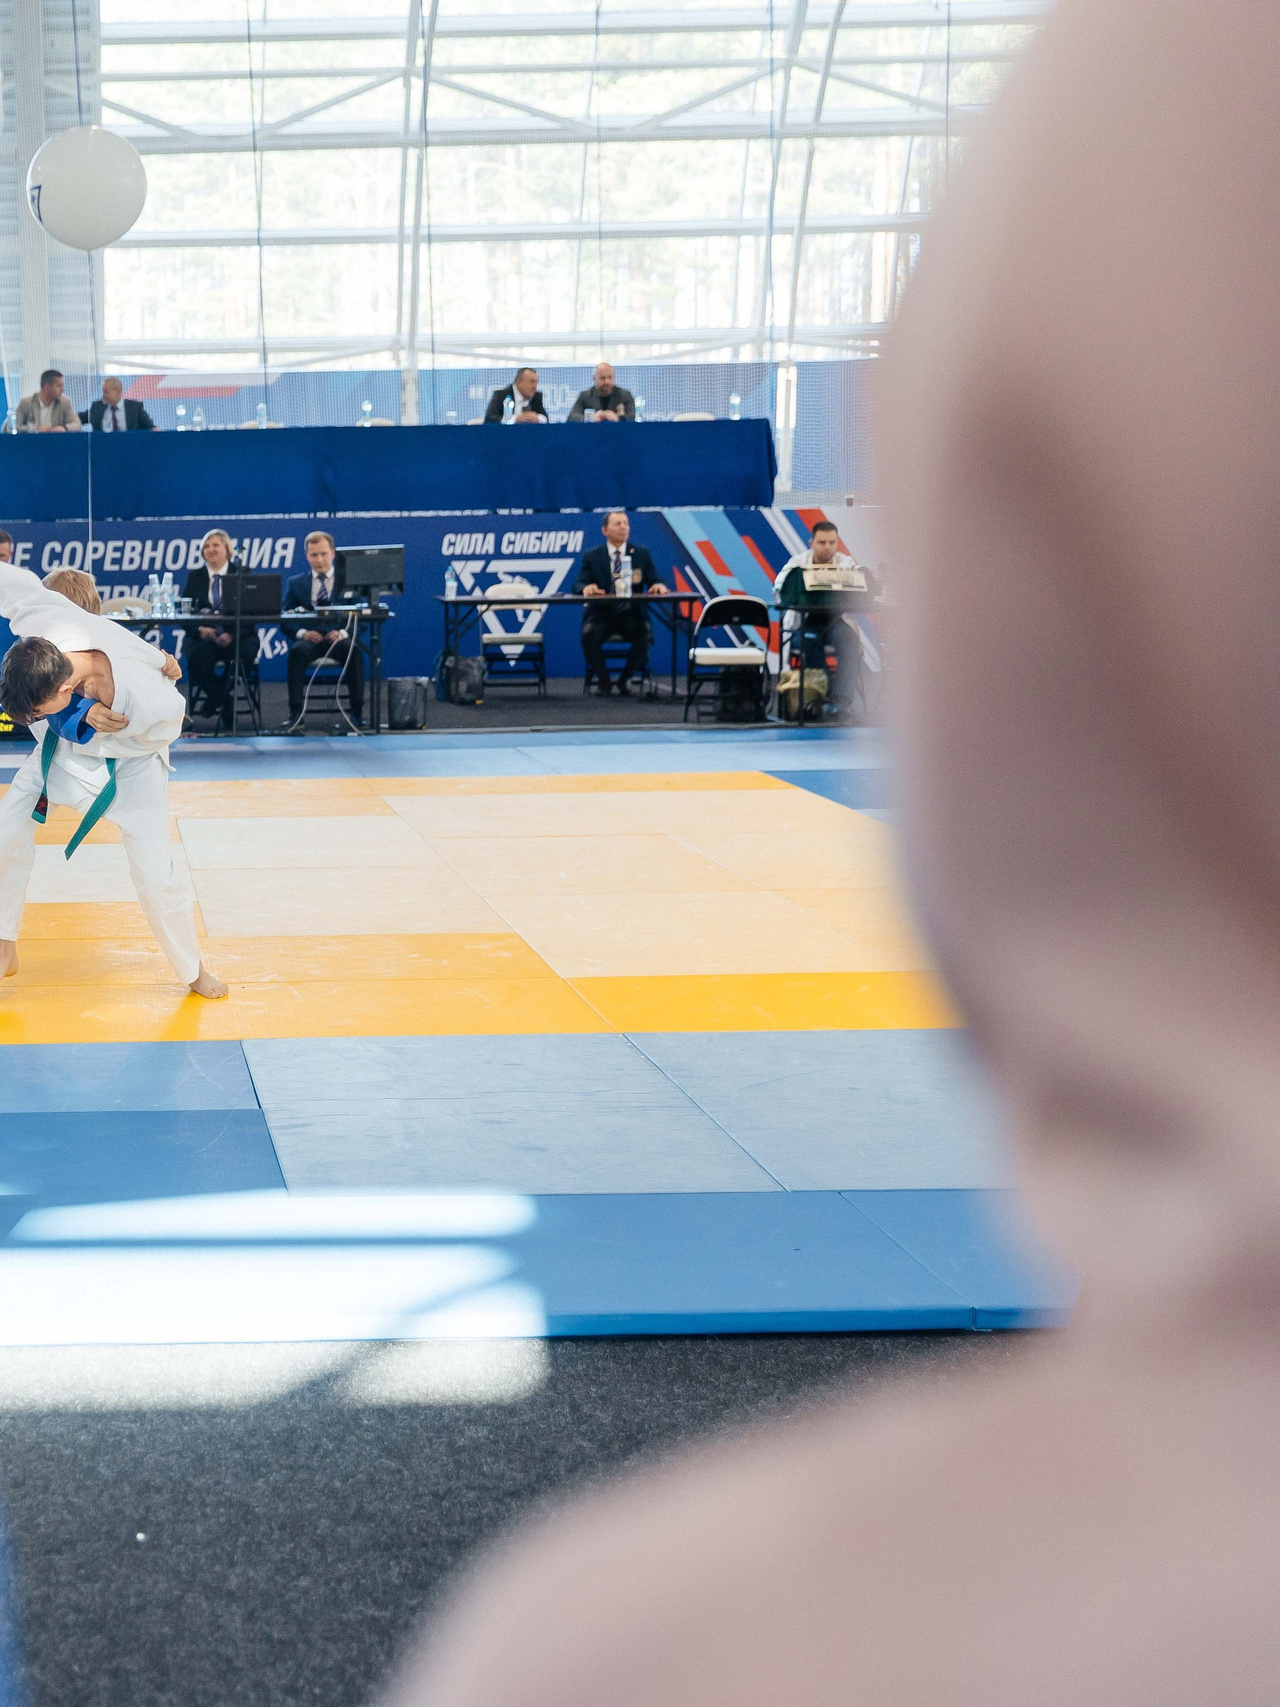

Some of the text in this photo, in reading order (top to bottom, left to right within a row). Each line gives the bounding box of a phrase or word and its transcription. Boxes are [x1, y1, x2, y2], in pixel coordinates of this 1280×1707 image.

[41, 536, 297, 573] СОРЕВНОВНИЯ
[441, 530, 584, 556] СИЛА СИБИРИ
